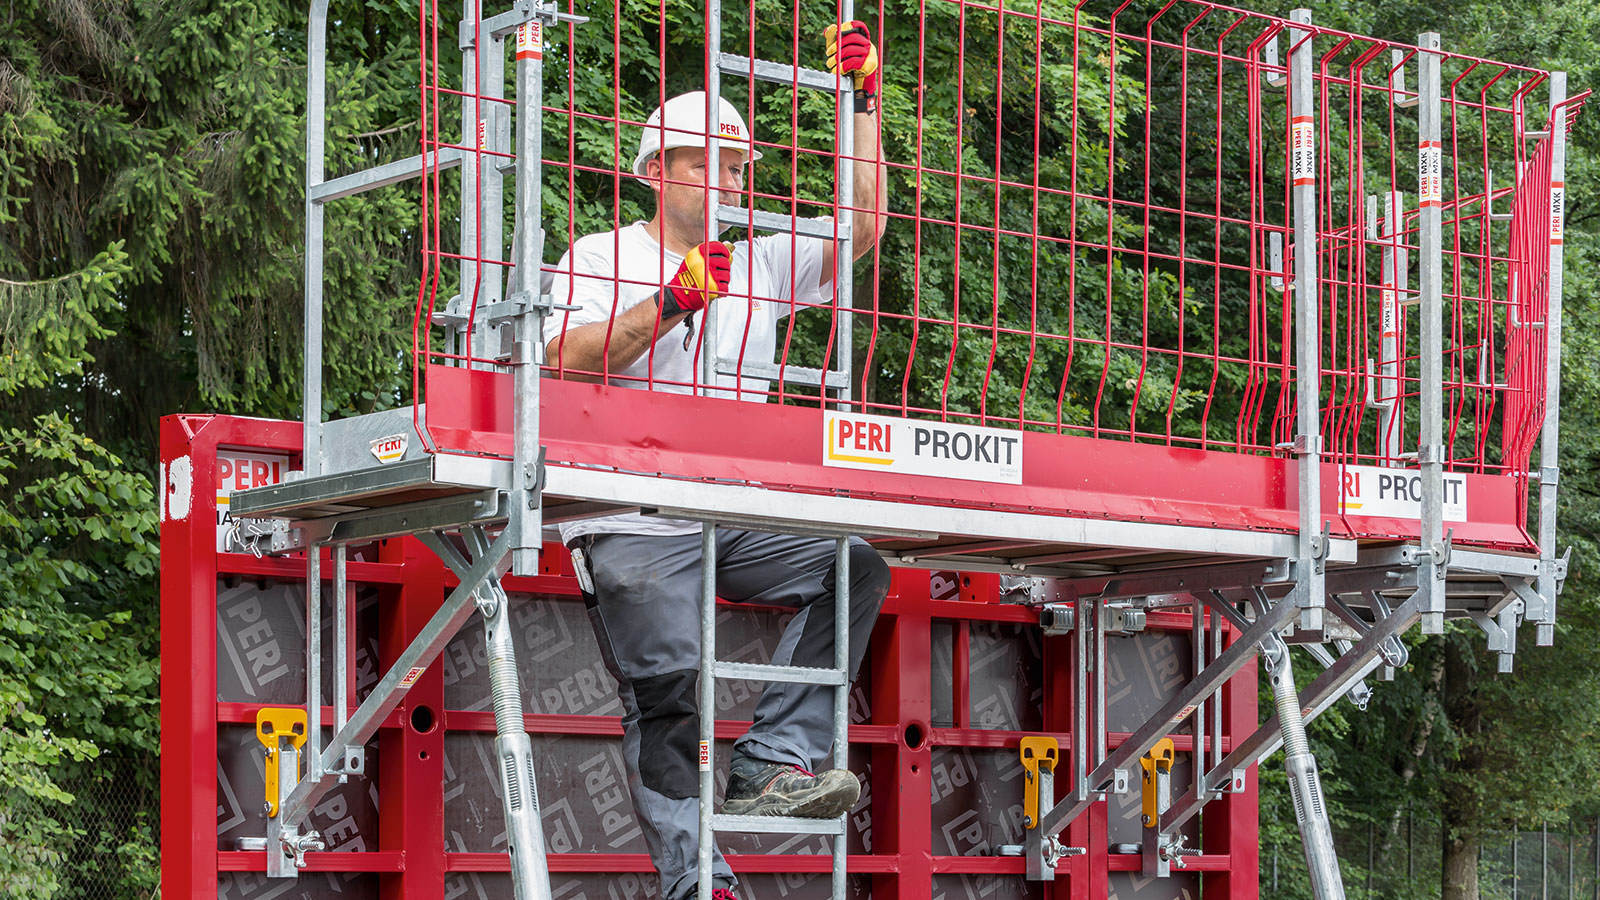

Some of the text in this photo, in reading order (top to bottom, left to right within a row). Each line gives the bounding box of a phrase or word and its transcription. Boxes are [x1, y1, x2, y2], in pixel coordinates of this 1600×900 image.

[531, 21, 540, 43] PERI
[720, 122, 740, 136] PERI
[1420, 151, 1428, 174] MXK
[1552, 192, 1561, 232] PERI MXK
[838, 419, 1018, 465] PERI PROKIT
[216, 457, 280, 491] PERI
[1378, 473, 1463, 505] PROIT
[226, 596, 290, 687] PERI
[403, 668, 421, 685] PERI
[541, 660, 613, 714] PERI
[701, 744, 710, 765] PERI
[577, 751, 634, 837] PERI
